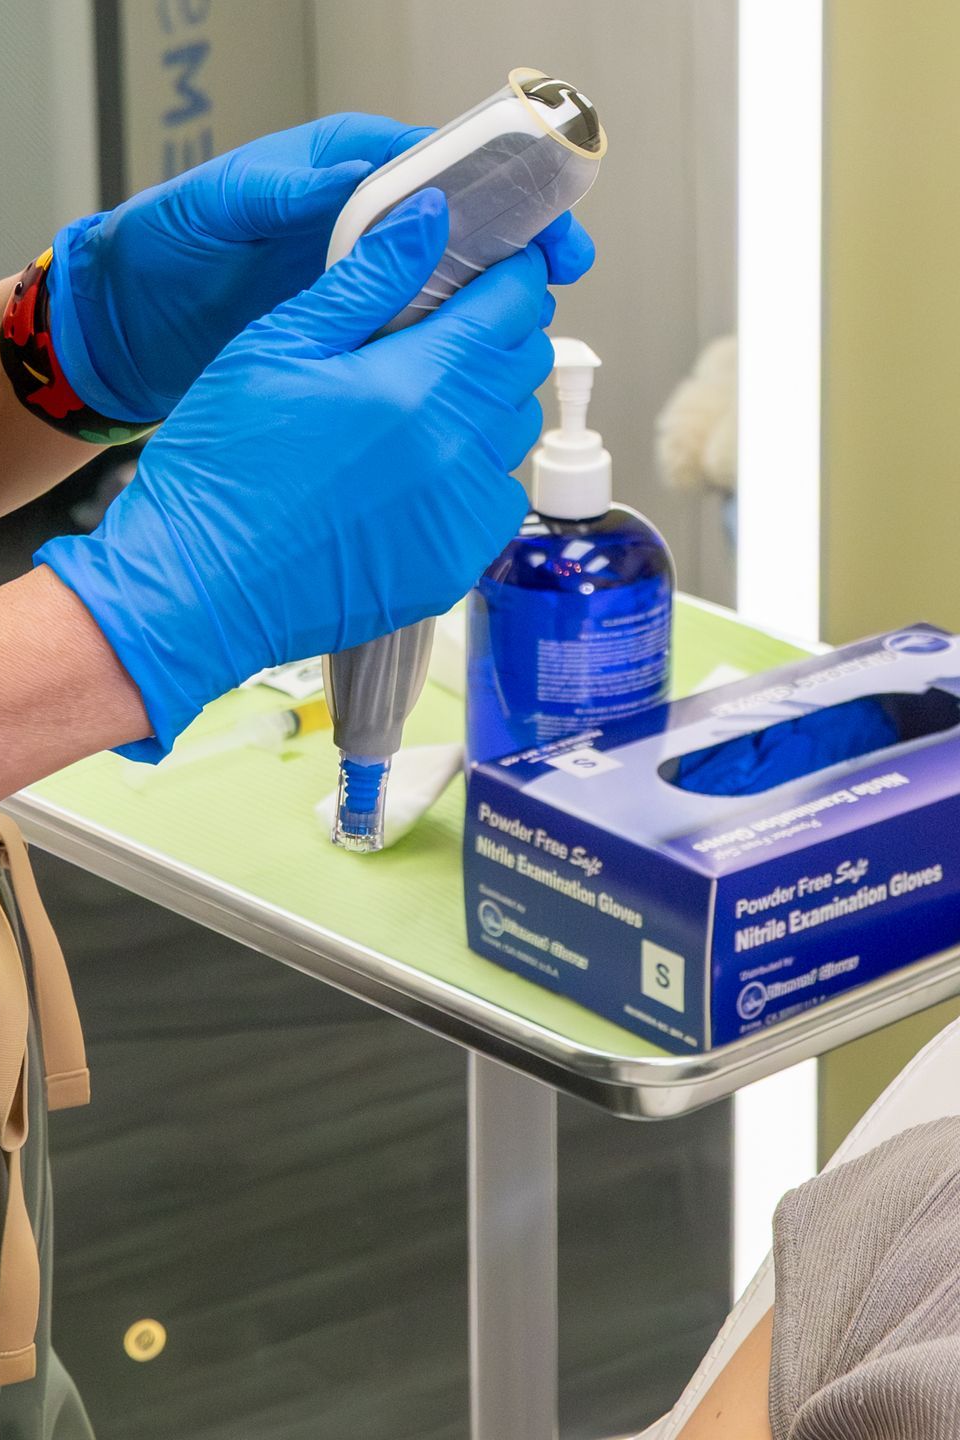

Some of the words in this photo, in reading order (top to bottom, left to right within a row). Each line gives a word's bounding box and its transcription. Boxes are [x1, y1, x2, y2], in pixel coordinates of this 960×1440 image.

[478, 801, 534, 844] Powder
[535, 827, 568, 860] Free
[475, 835, 516, 870] Nitrile
[516, 853, 597, 908] Examination
[597, 892, 643, 929] Gloves
[734, 918, 787, 953] Nitrile
[788, 883, 888, 934] Examination
[889, 863, 944, 897] Gloves
[735, 885, 796, 919] Powder
[797, 873, 833, 897] Free
[655, 963, 670, 989] S
